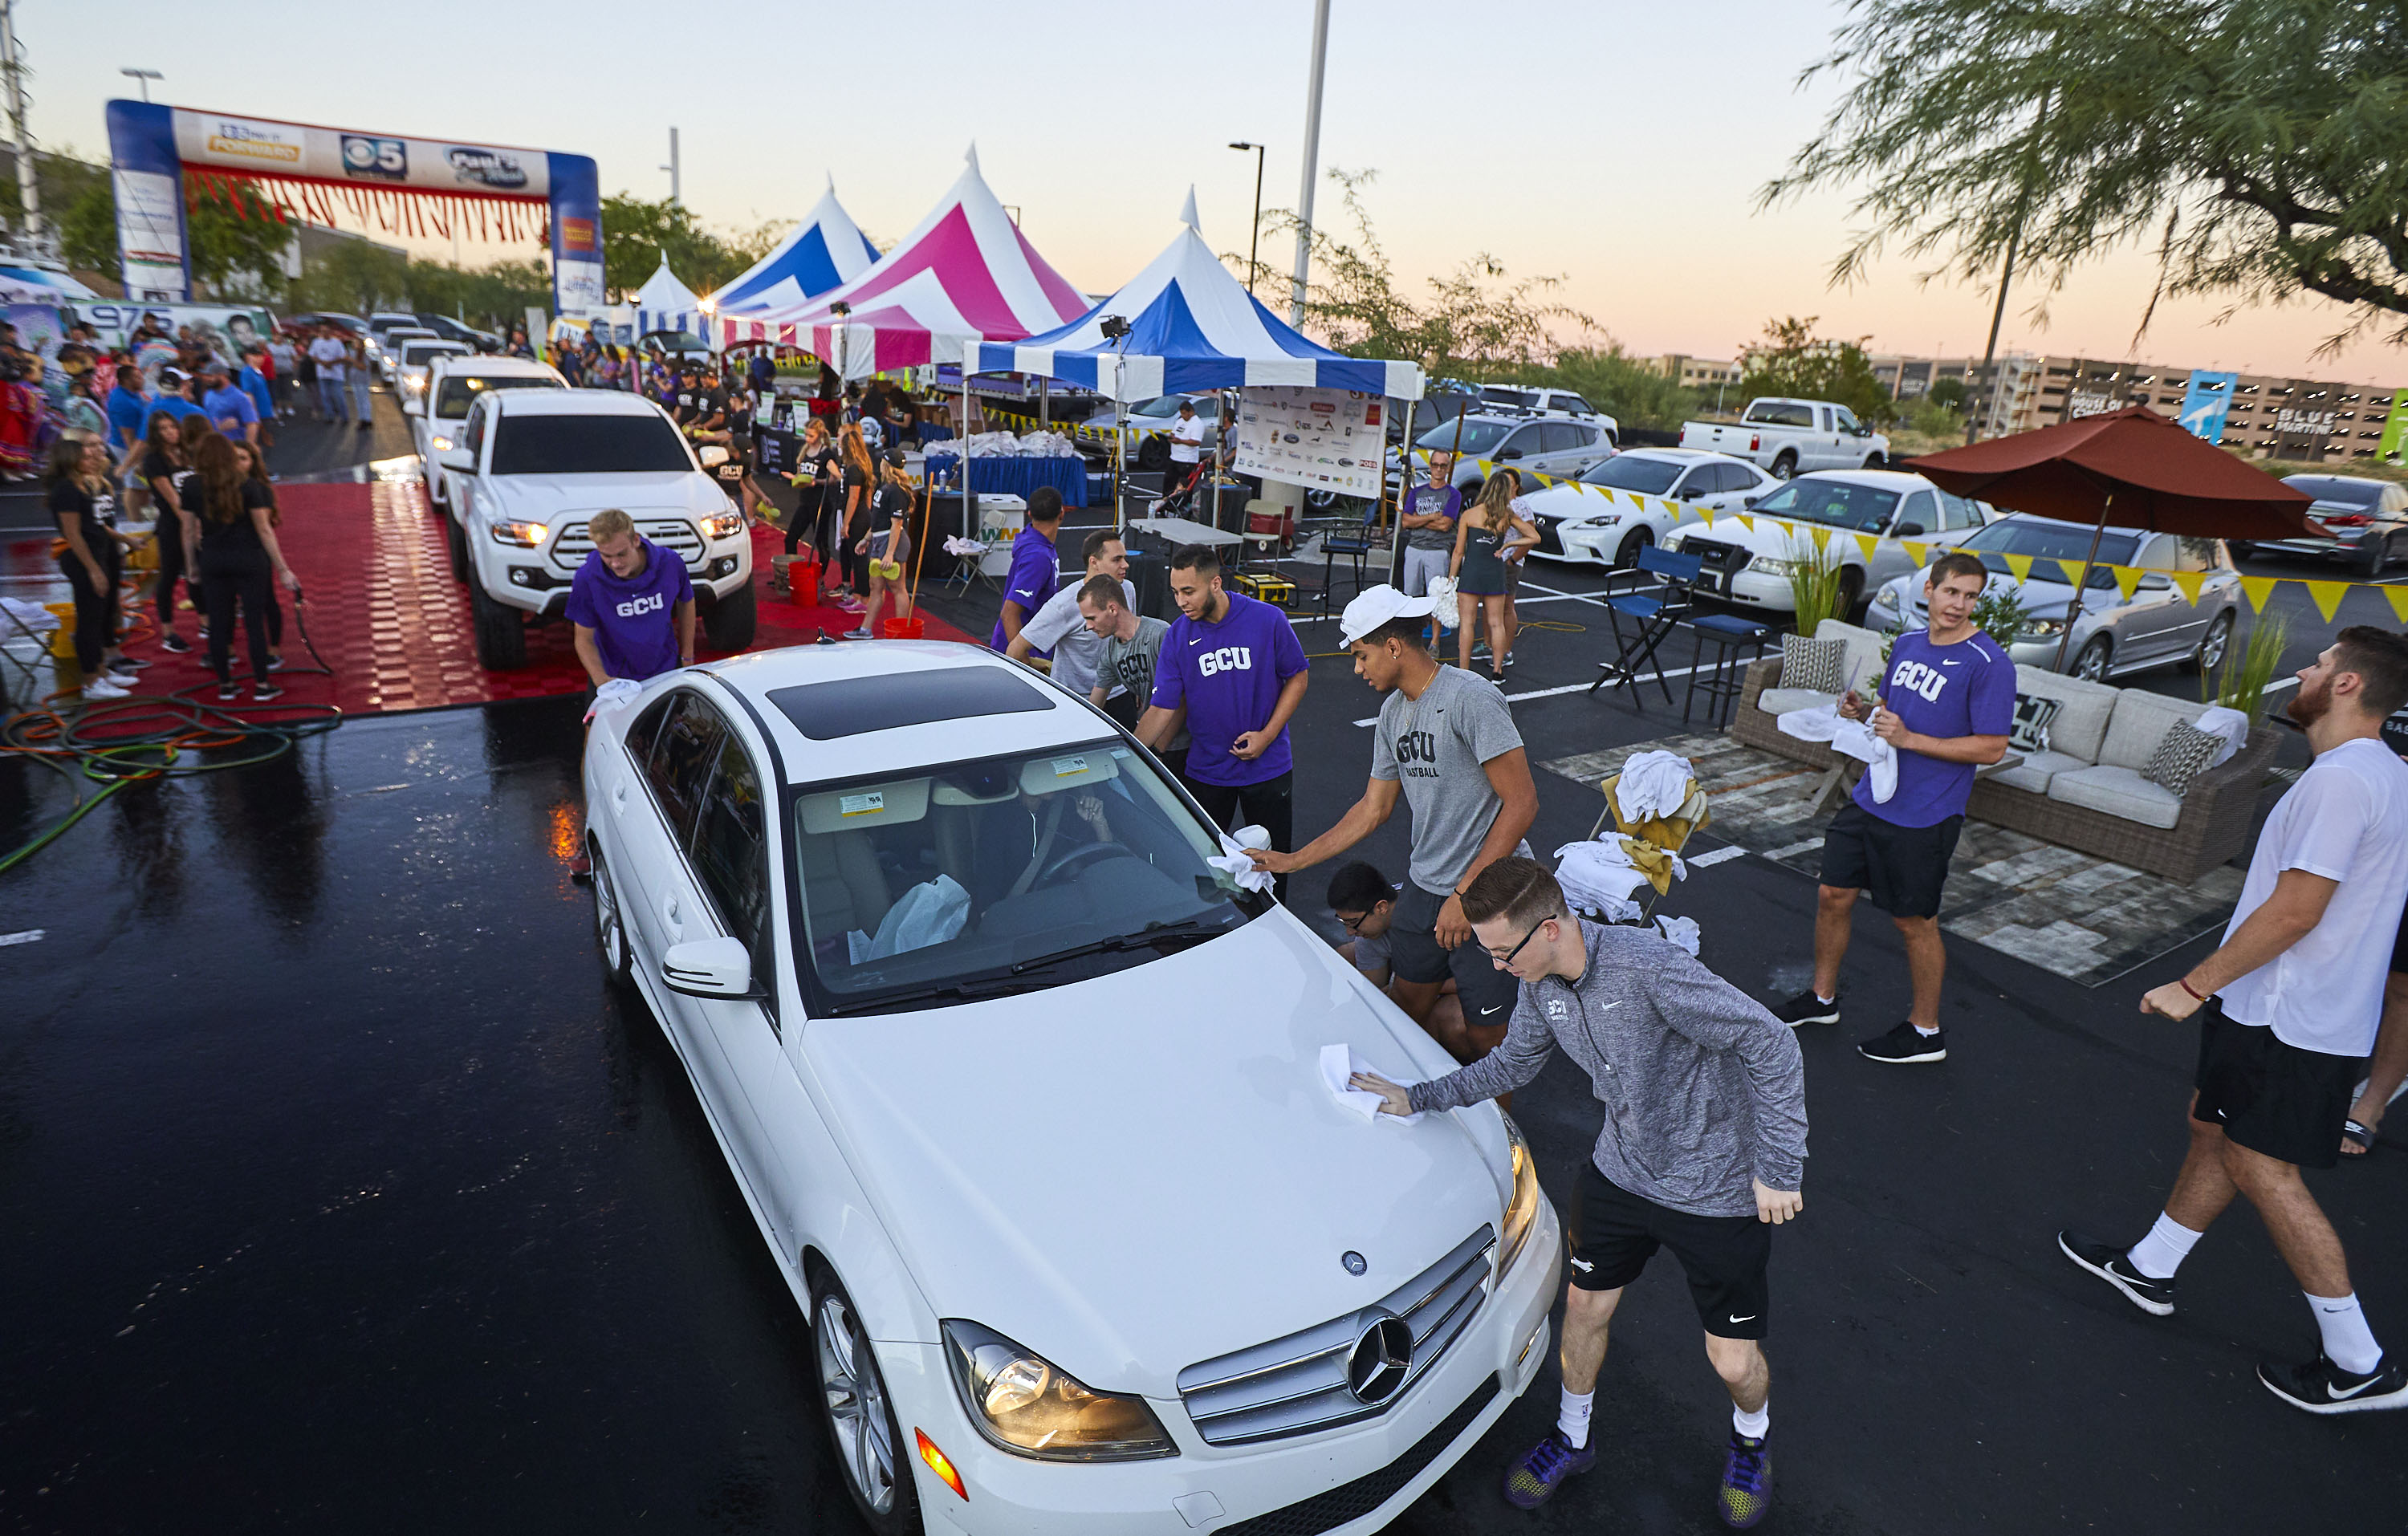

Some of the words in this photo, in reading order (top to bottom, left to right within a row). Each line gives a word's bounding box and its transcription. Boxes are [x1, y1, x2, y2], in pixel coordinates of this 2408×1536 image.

[213, 138, 297, 161] FORWARD
[377, 140, 404, 172] 5
[2274, 421, 2333, 435] MARTINI
[2277, 408, 2336, 425] BLUE
[981, 527, 1021, 541] WM
[616, 592, 664, 617] GCU
[1117, 653, 1149, 679] GCU
[1198, 647, 1251, 677] GCU
[1890, 660, 1948, 702] GCU
[1396, 731, 1436, 763] GCU
